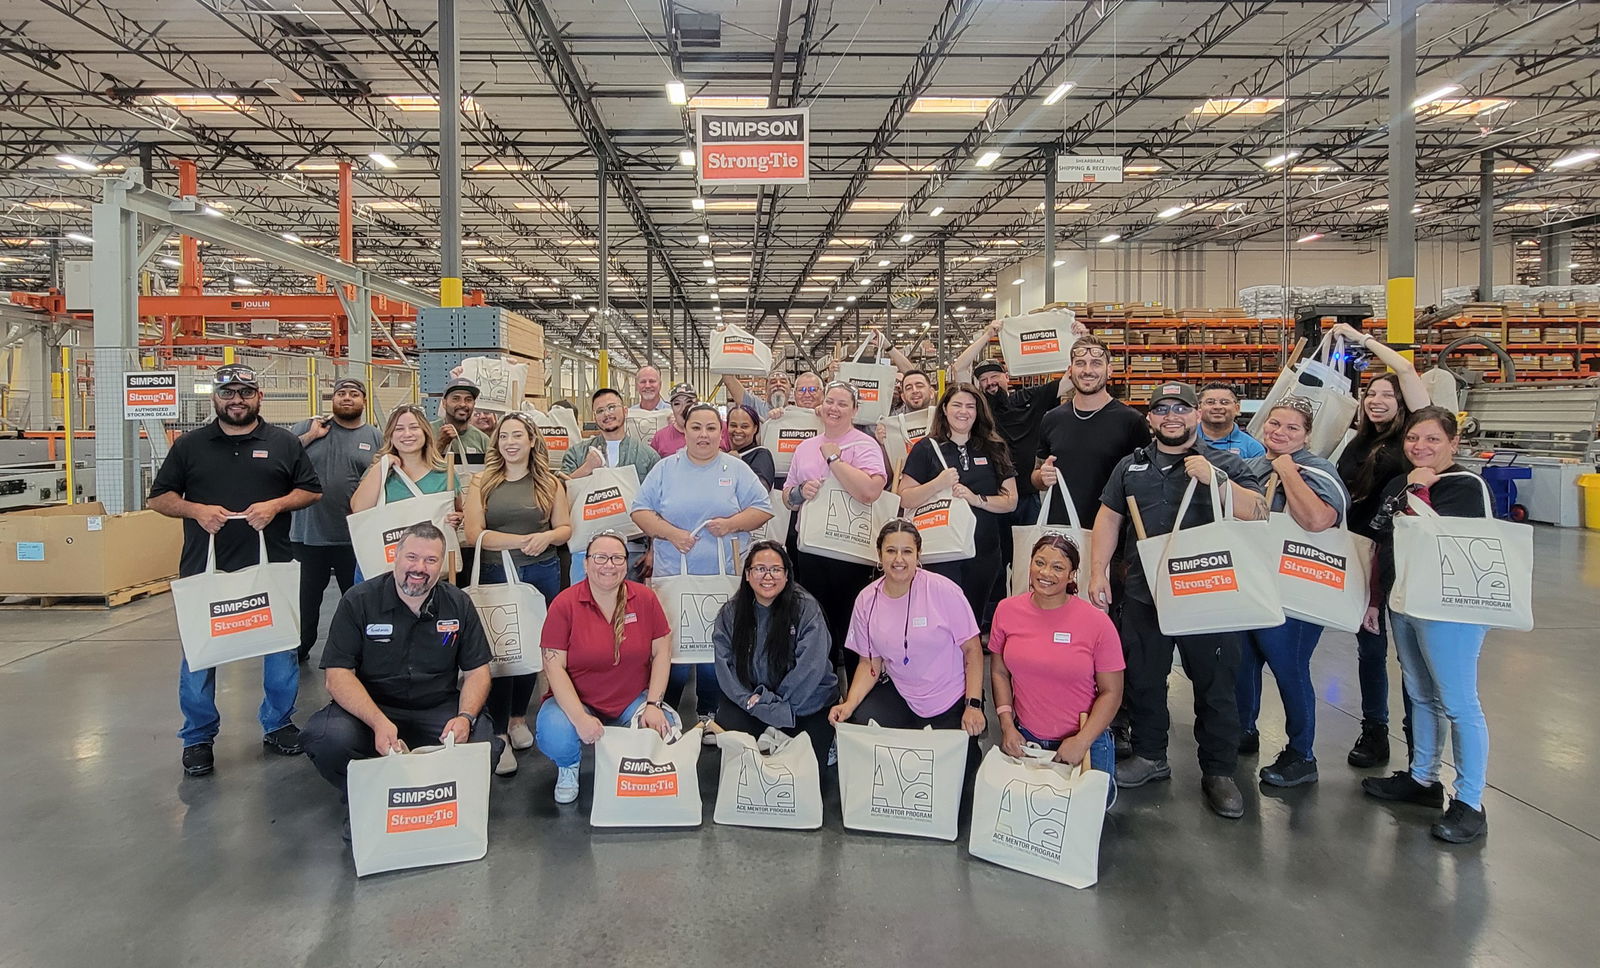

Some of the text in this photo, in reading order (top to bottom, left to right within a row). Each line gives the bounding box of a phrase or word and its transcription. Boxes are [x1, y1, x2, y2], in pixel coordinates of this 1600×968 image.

[708, 120, 798, 137] SIMPSON
[708, 152, 798, 172] Strong-Tie
[243, 301, 270, 309] JOULIN
[1022, 331, 1056, 340] SIMPSON
[130, 376, 173, 386] SIMPSON
[129, 392, 174, 403] Strong-Tie
[1171, 554, 1229, 571] SIMPSON
[1287, 544, 1343, 567] SIMPSON
[1284, 560, 1342, 583] Strong-Tie
[1174, 575, 1232, 590] Strong-Tie
[213, 596, 266, 614] SIMPSON
[1481, 600, 1512, 608] PROGRAM
[214, 613, 269, 631] Strong-Tie
[622, 761, 672, 774] SIMPSON
[620, 779, 674, 793] Strong-Tie
[393, 786, 453, 804] SIMPSON
[391, 808, 454, 826] Strong-Tie
[882, 808, 905, 816] MENTOR
[906, 810, 933, 819] PROGRAM
[993, 832, 1004, 841] ACE
[1005, 836, 1030, 850] MENTOR
[1030, 845, 1061, 861] PROGRAM
